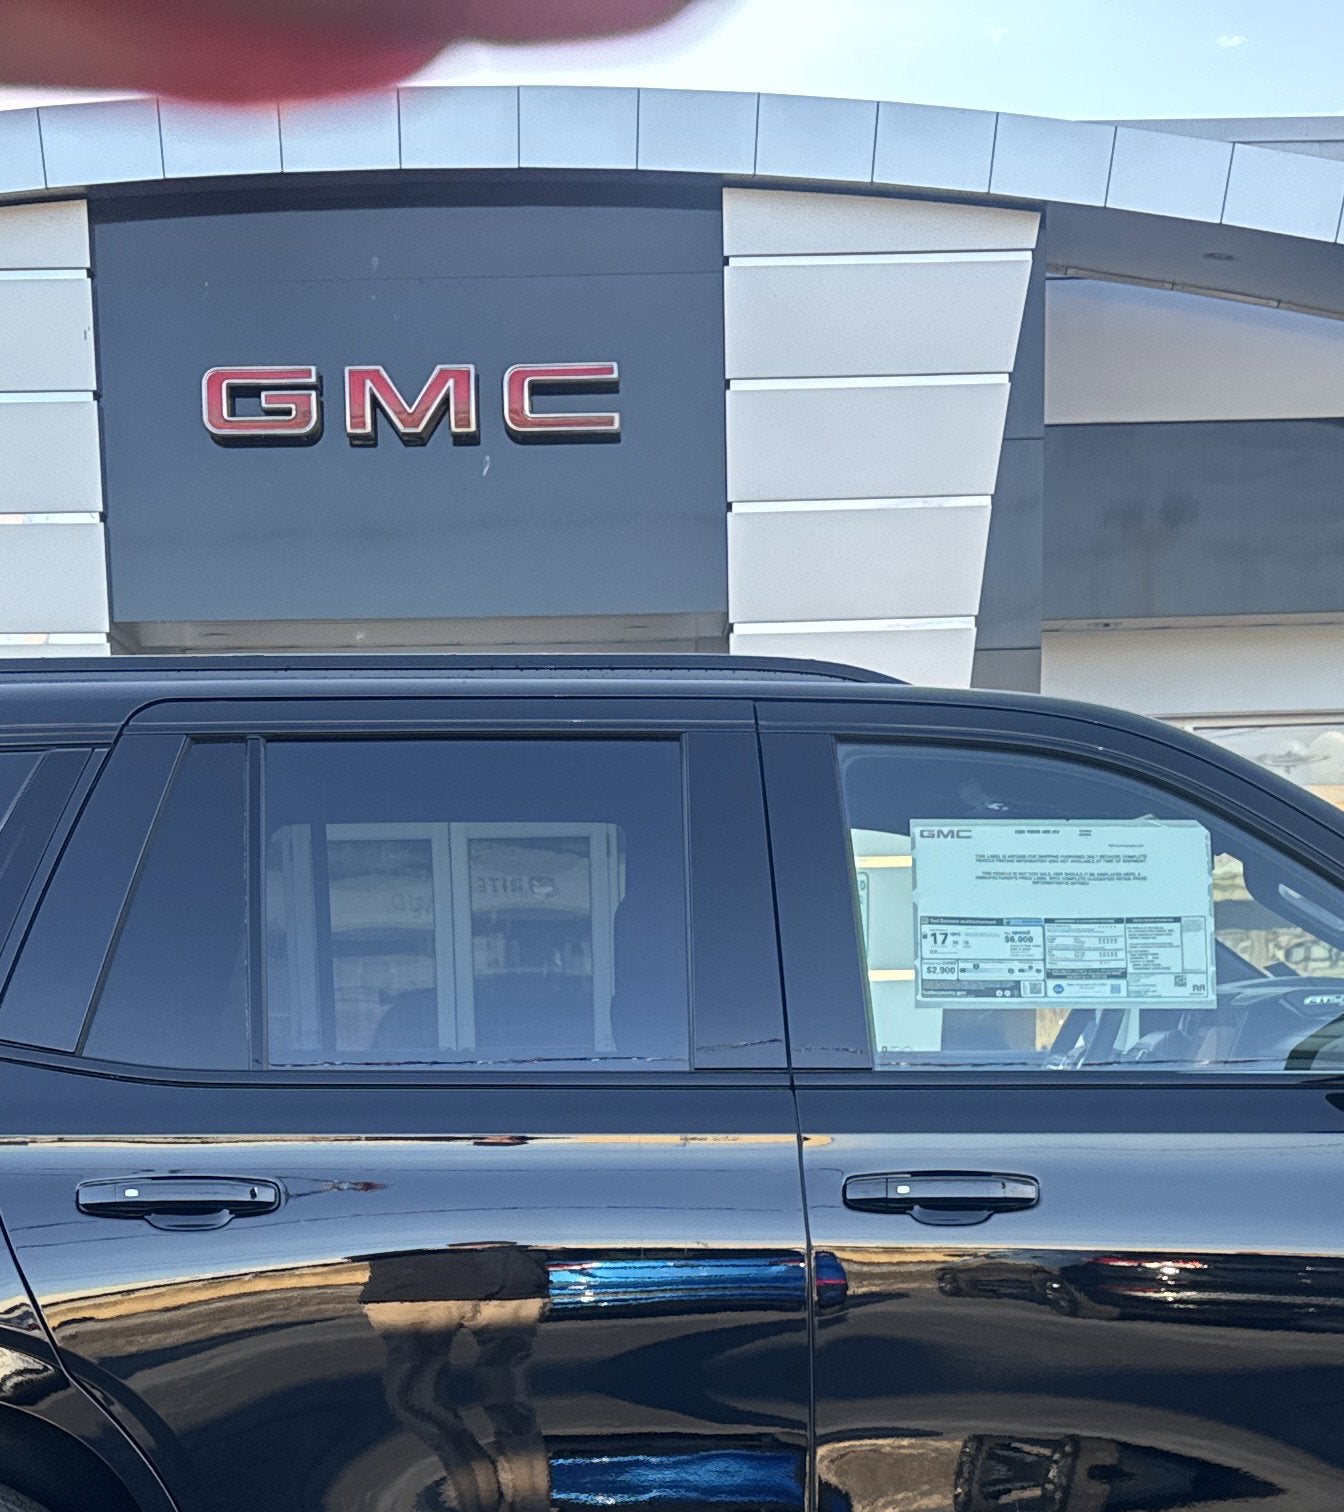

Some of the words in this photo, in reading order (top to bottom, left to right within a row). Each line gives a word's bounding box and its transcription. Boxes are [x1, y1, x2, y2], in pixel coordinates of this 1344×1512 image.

[201, 361, 622, 443] GMC
[920, 829, 972, 839] GMC
[930, 932, 949, 945] 17
